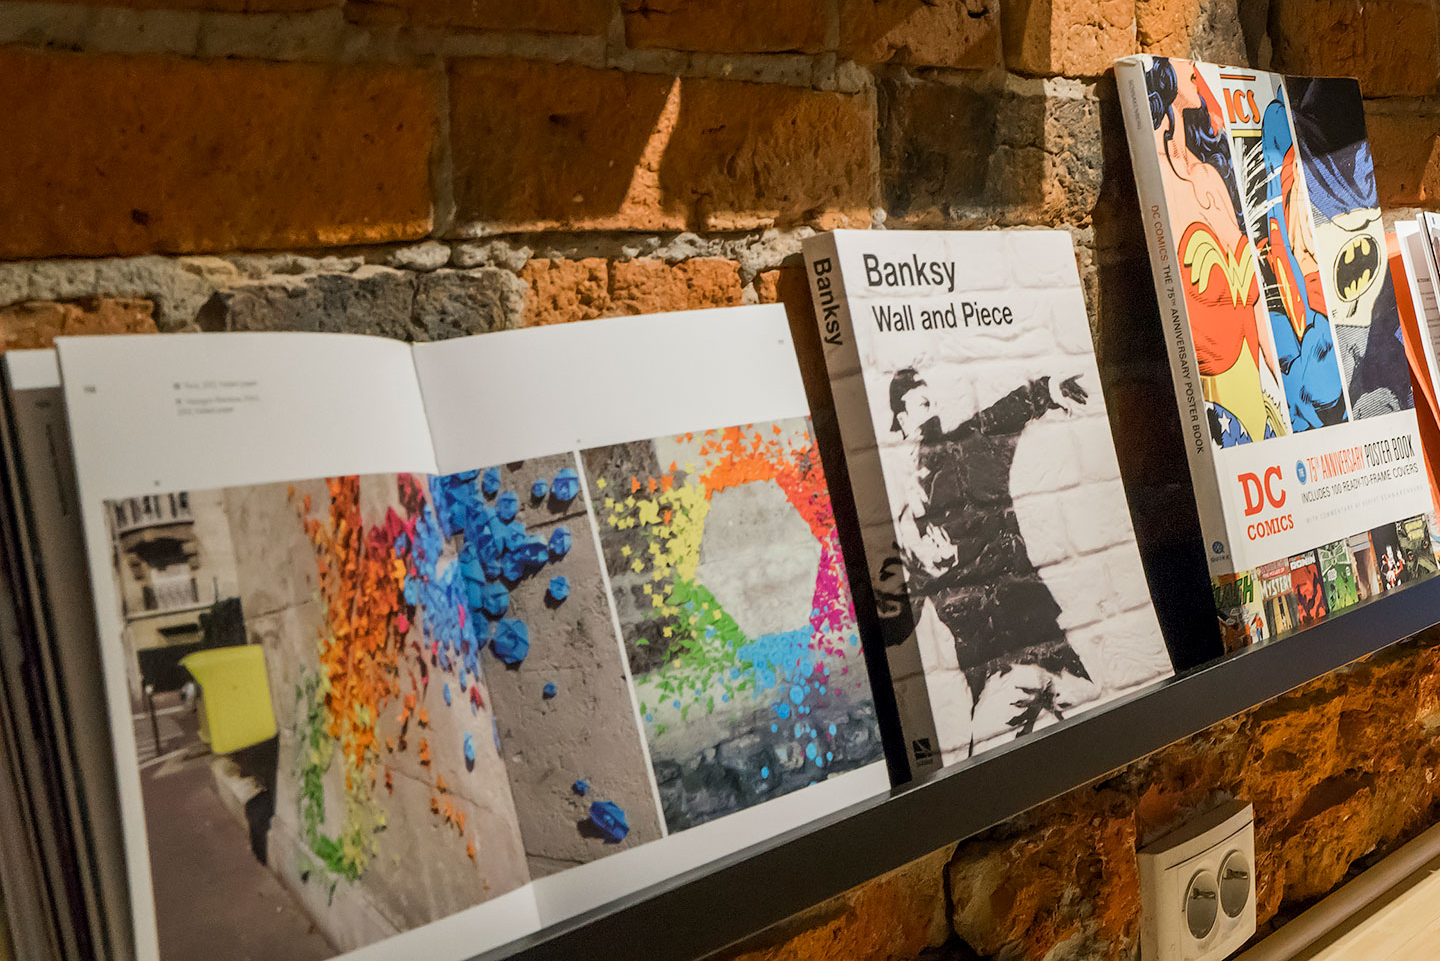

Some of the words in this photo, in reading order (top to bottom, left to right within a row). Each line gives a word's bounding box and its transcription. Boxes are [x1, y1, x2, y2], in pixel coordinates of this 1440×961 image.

[863, 253, 956, 292] Banksy
[812, 256, 844, 347] Banksy
[872, 304, 916, 333] Wall
[921, 302, 958, 330] and
[962, 301, 1014, 327] Piece
[1151, 204, 1160, 219] DC
[1163, 264, 1173, 285] THE
[1170, 308, 1191, 382] ANNIVERSARY
[1185, 382, 1198, 422] POSTER
[1192, 424, 1205, 454] BOOK
[1320, 446, 1365, 479] ANNIVERSARY
[1364, 439, 1393, 468] POSTER
[1391, 434, 1415, 460] BOOK
[1238, 465, 1286, 517] DC
[1301, 486, 1331, 504] INCLUDES
[1343, 470, 1392, 492] READY-TO-FRAME
[1393, 463, 1419, 479] COVERS
[1247, 514, 1294, 541] COMICS
[1263, 572, 1292, 599] MYSTERY
